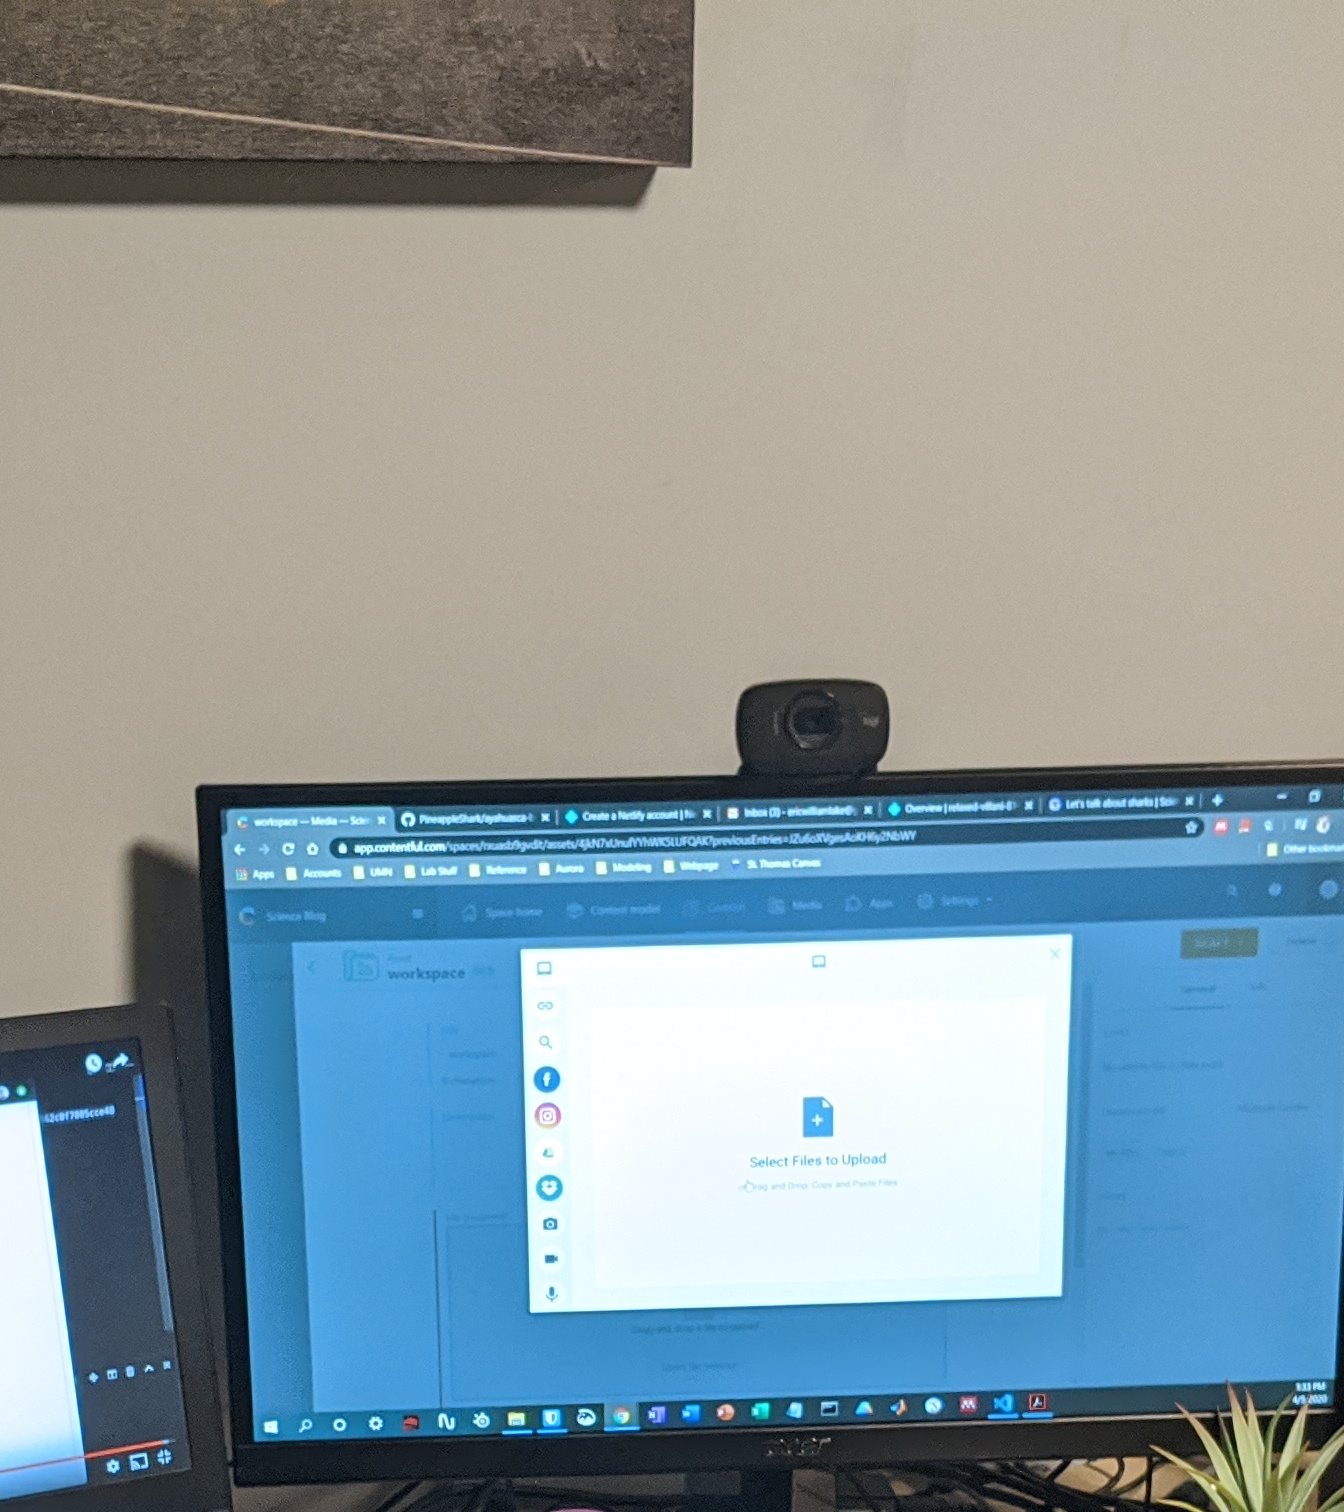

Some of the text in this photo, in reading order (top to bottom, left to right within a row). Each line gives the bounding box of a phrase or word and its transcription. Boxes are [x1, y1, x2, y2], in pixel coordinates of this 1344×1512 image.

[905, 802, 943, 815] Overview
[1066, 797, 1084, 810] Let's
[1086, 797, 1101, 809] talk
[1102, 796, 1127, 809] about
[1128, 795, 1153, 808] sharks
[582, 811, 609, 822] Create
[618, 810, 645, 824] Netlify
[646, 810, 678, 822] account
[744, 807, 768, 819] Inbox
[1283, 843, 1307, 854] Other
[486, 864, 527, 876] Reference
[556, 863, 584, 874] Aurora
[613, 861, 652, 875] Modeling
[680, 860, 719, 873] Webpage
[759, 858, 791, 870] Thomas
[253, 869, 274, 880] Apps
[303, 867, 341, 879] Accounts
[421, 865, 458, 877] Lab Stuff
[387, 966, 466, 983] workspace
[749, 1152, 887, 1169] Select Files to Upload
[811, 1180, 833, 1192] Copy
[835, 1179, 850, 1190] and
